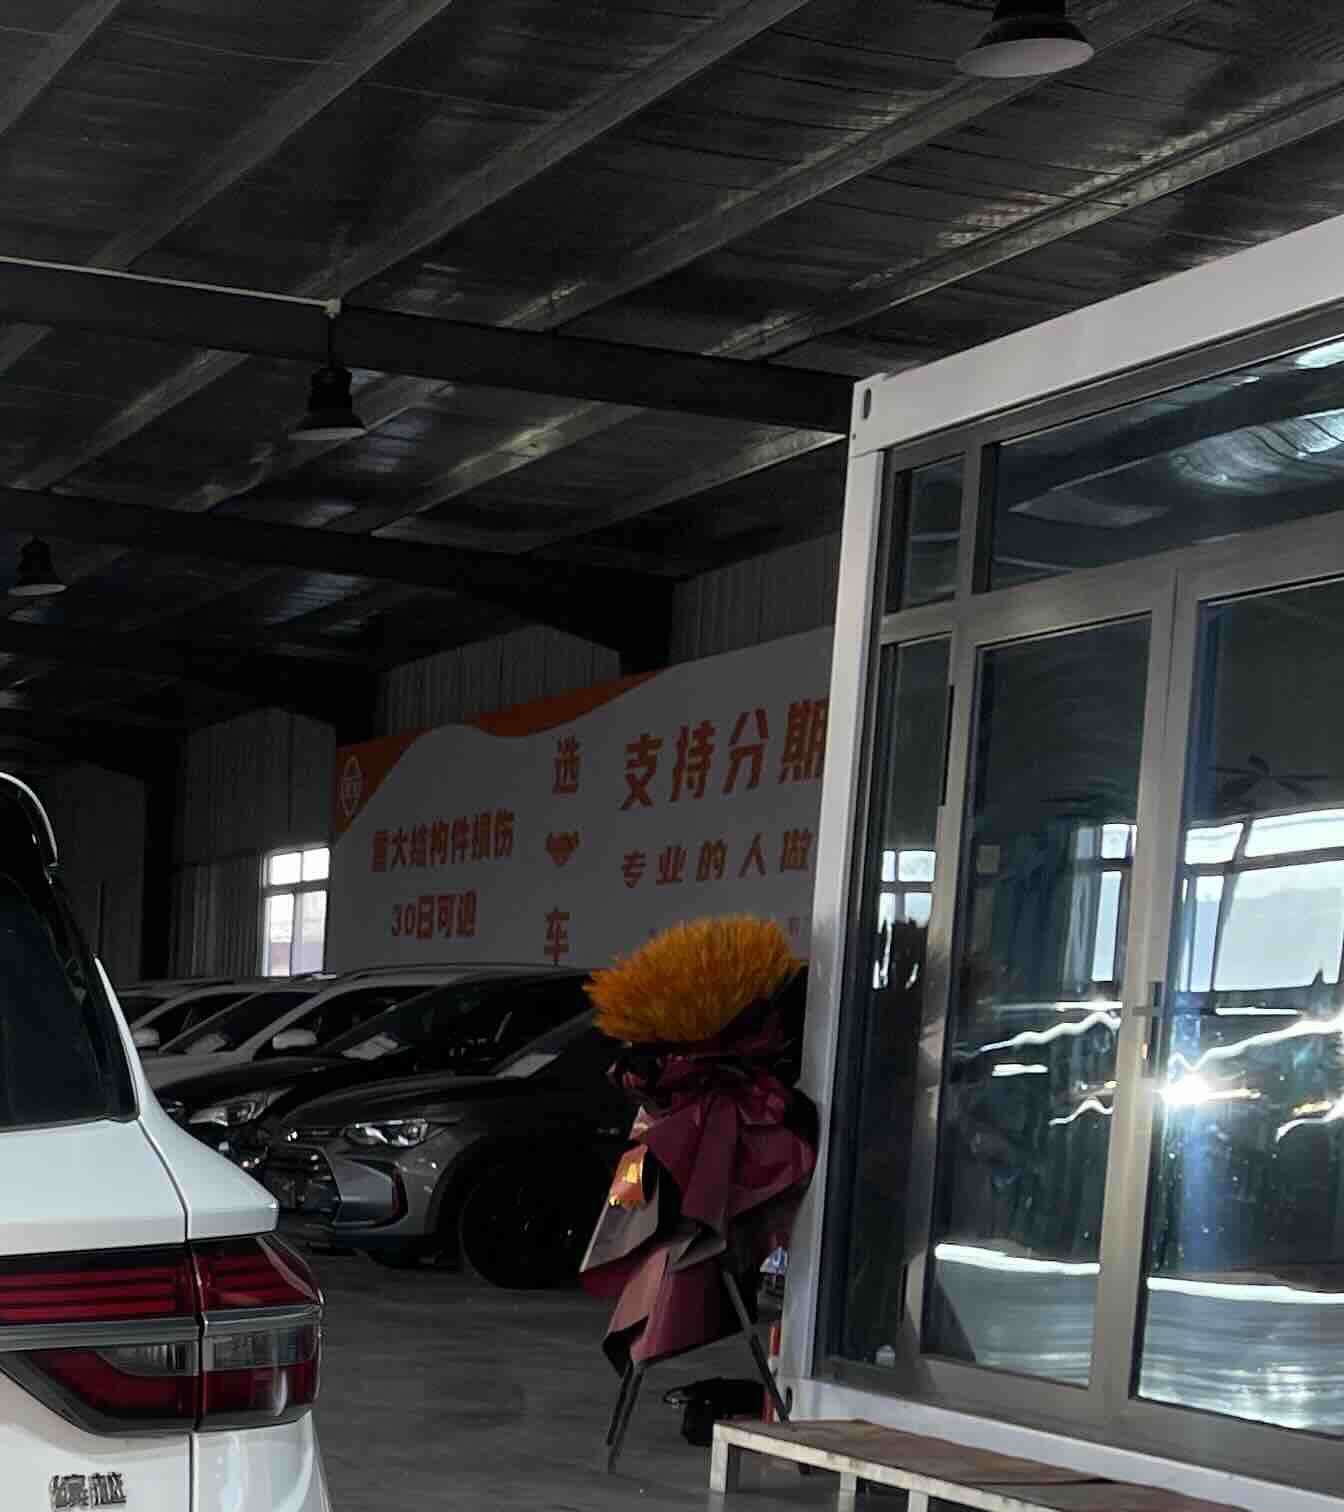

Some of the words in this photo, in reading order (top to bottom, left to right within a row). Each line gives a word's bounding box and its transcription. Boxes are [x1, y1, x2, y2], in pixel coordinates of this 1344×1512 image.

[620, 697, 830, 810] 支持分期
[392, 889, 477, 940] 30日可退
[543, 906, 571, 966] 车
[50, 1472, 127, 1511] 缤越
